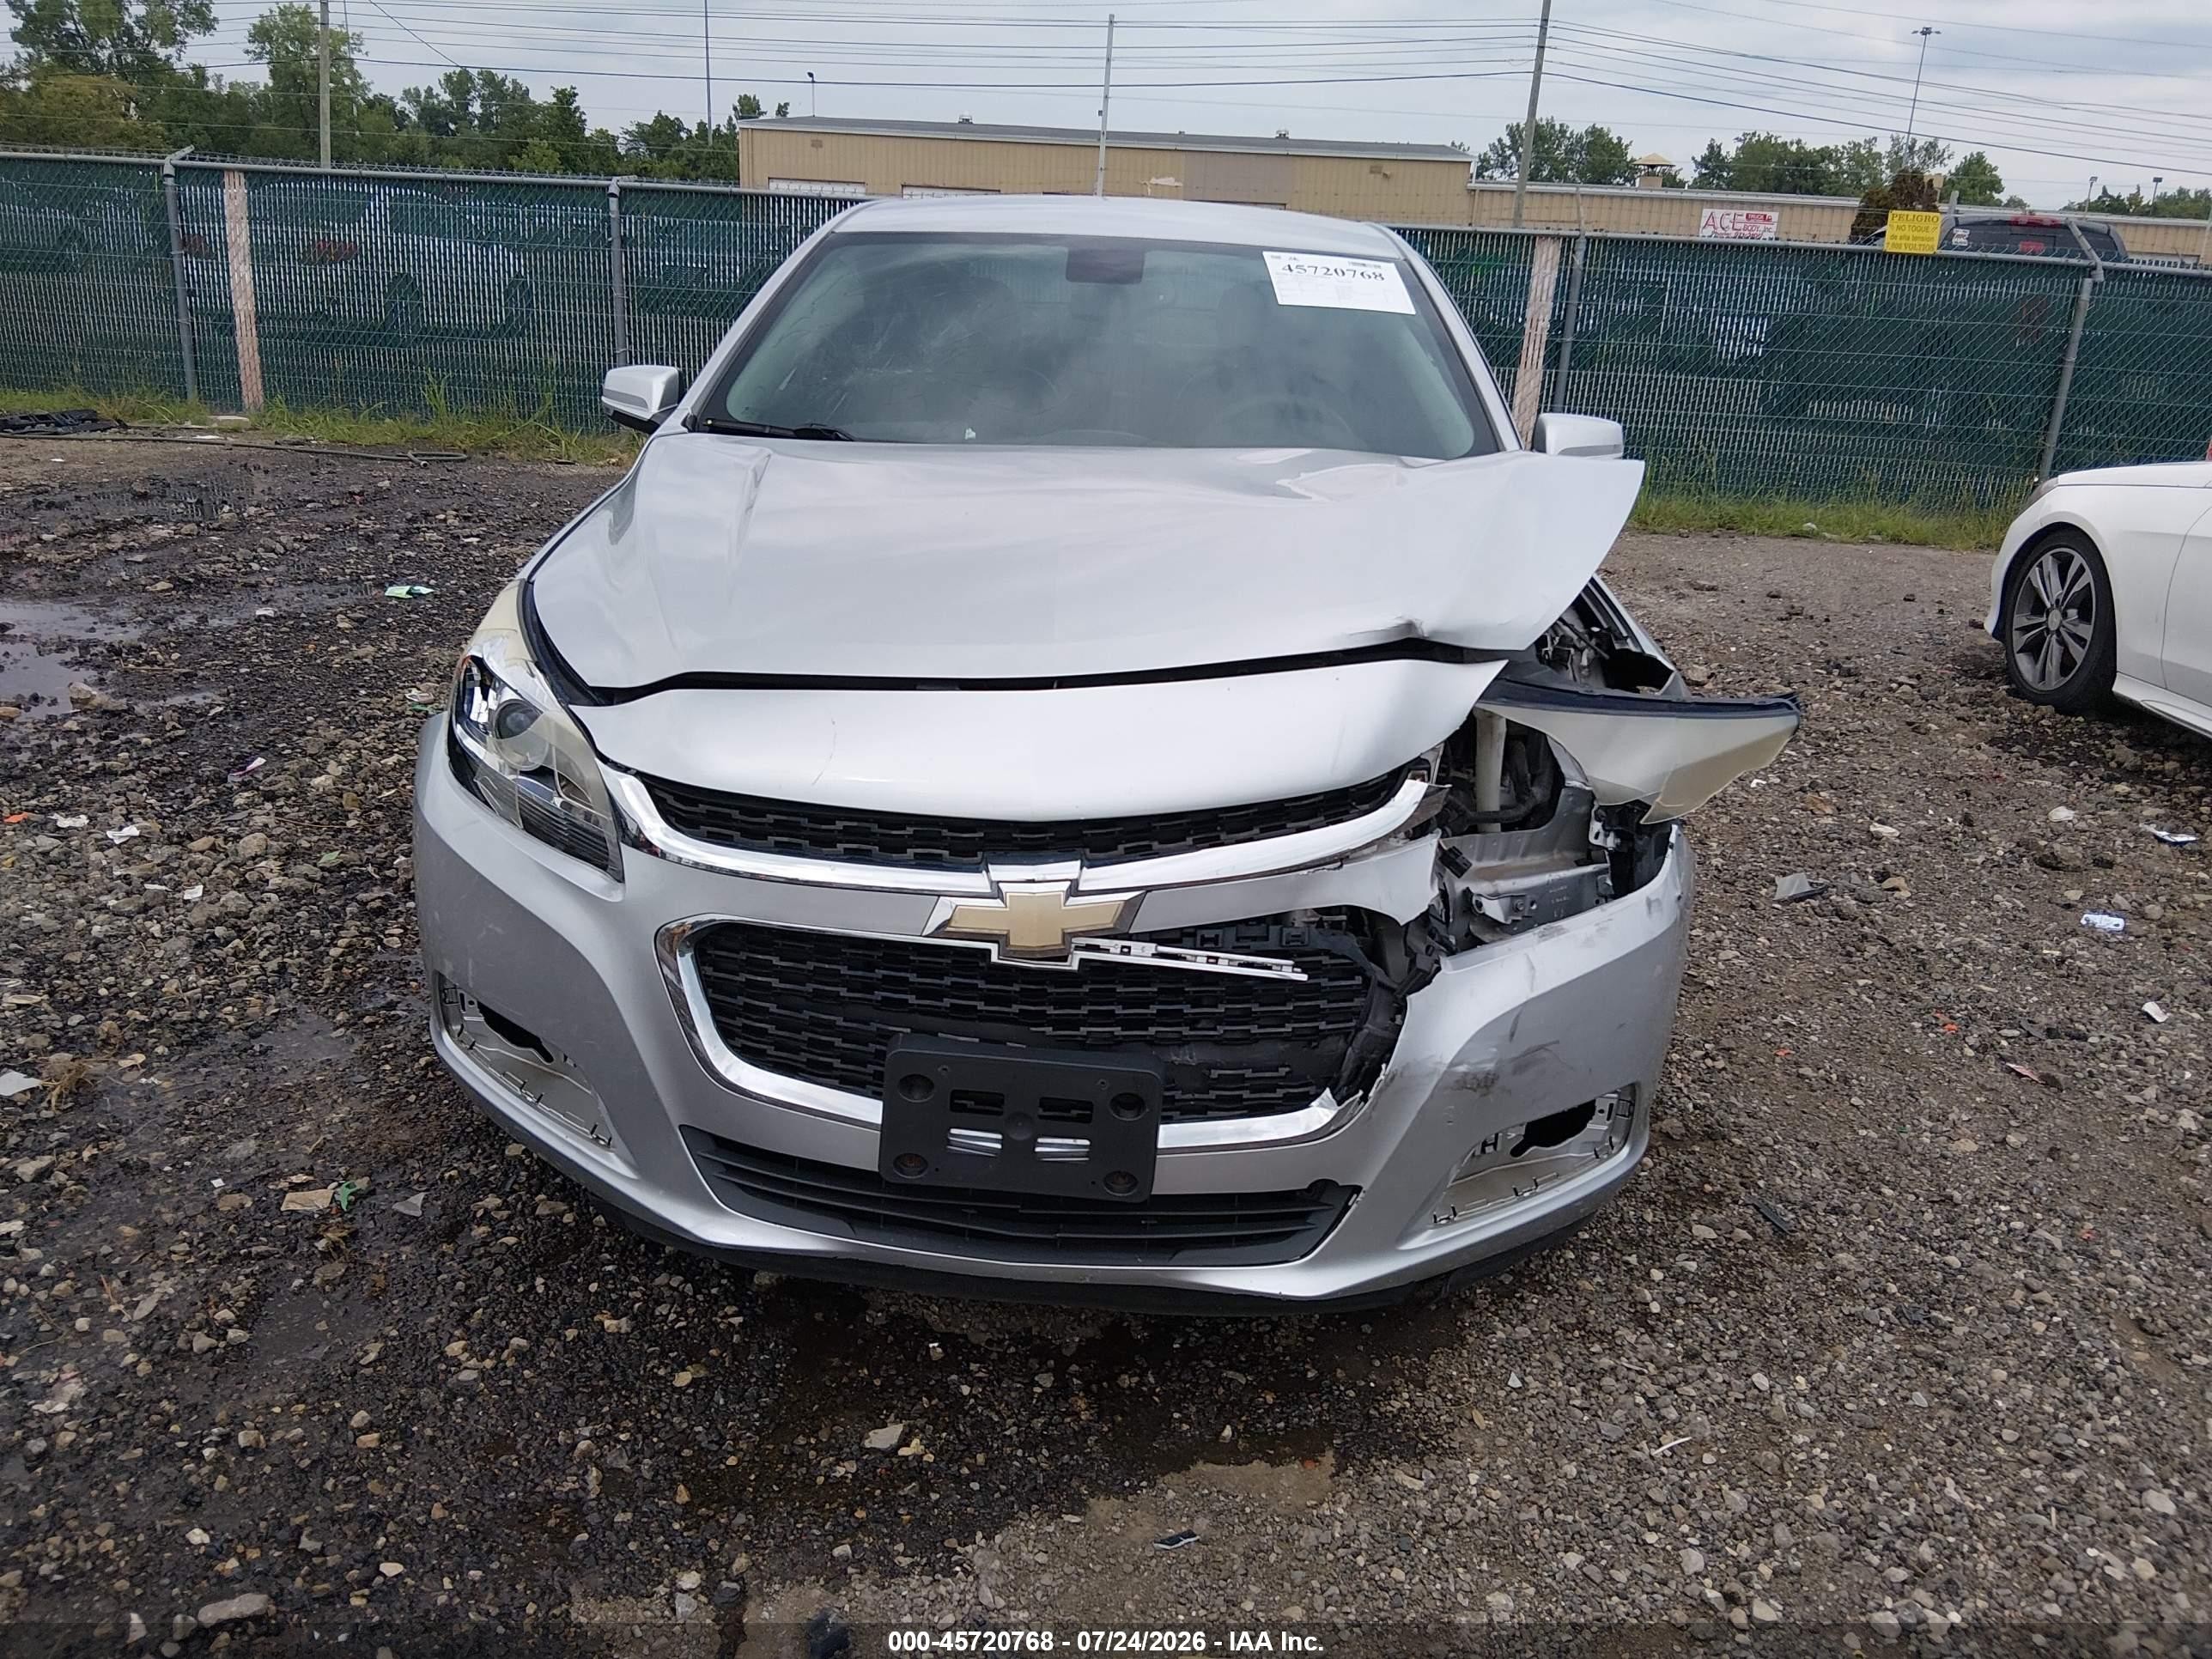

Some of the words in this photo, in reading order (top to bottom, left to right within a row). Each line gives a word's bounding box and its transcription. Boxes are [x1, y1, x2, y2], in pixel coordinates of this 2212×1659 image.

[1702, 212, 1743, 231] ACE
[1891, 213, 1939, 223] PELIGRO
[1904, 242, 1936, 252] VOLTIOS
[1282, 264, 1385, 282] 45720768
